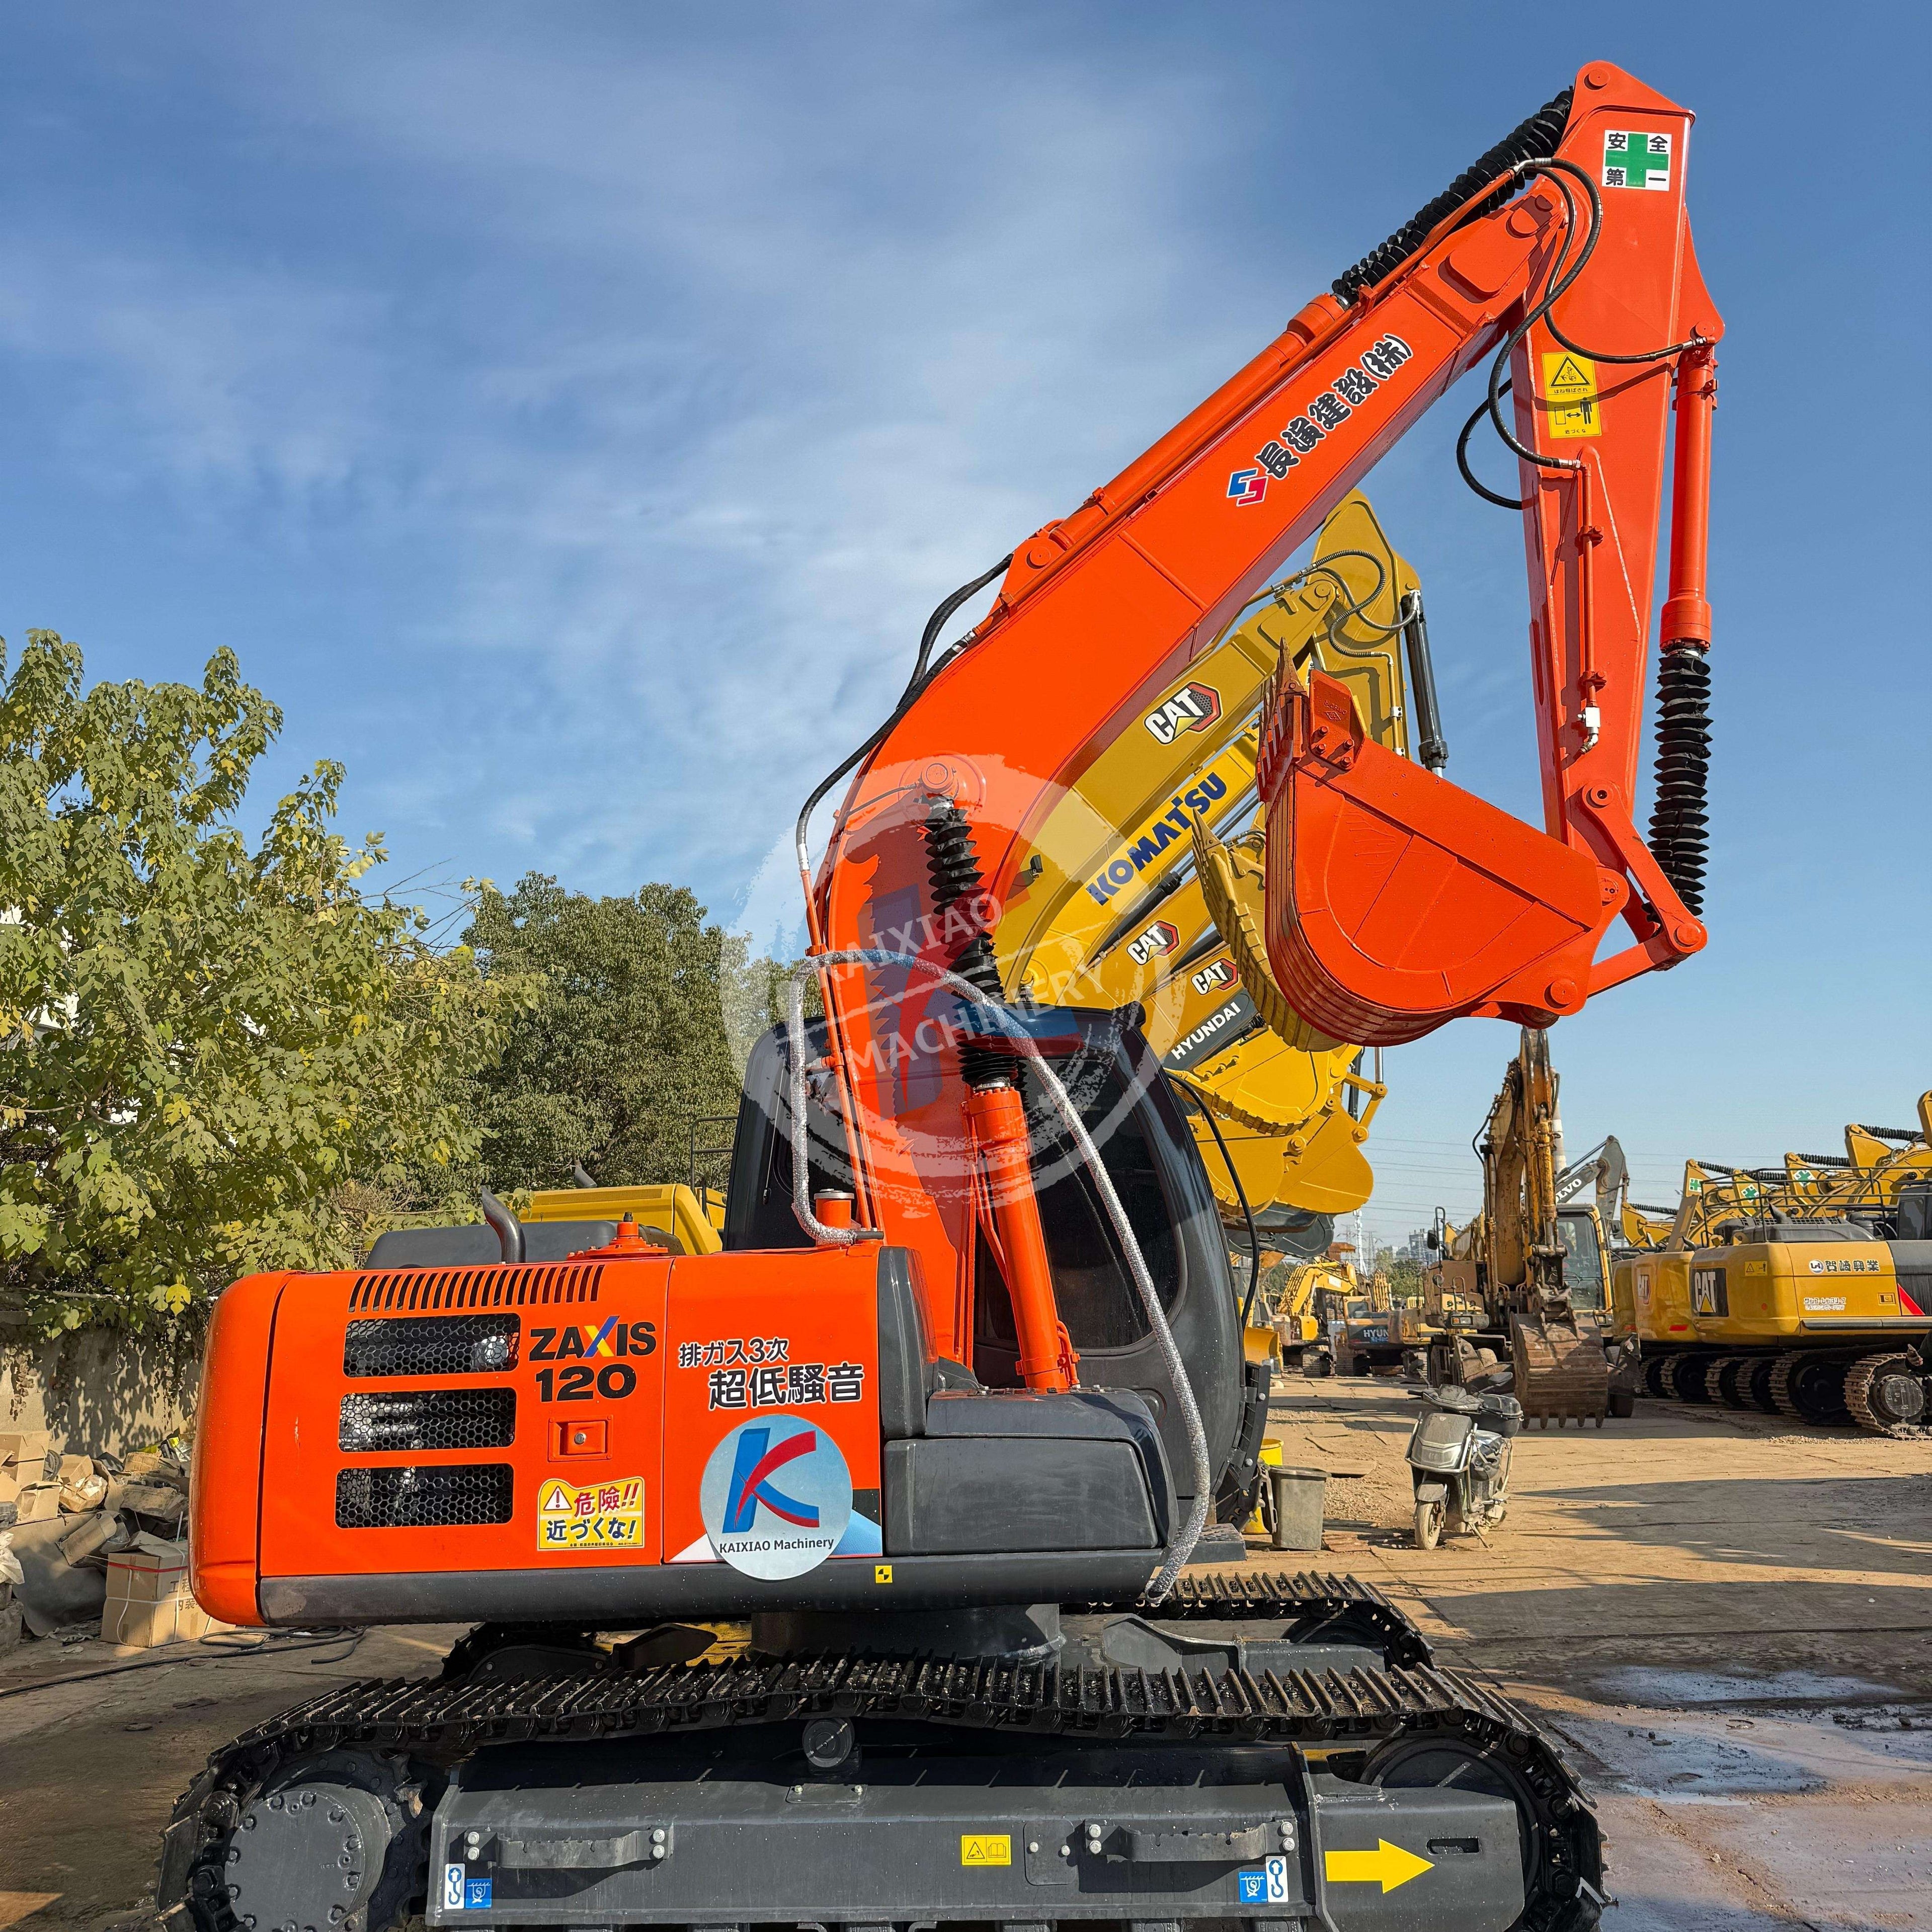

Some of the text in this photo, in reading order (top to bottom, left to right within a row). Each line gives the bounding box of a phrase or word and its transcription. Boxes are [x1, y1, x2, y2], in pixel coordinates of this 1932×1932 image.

[1145, 687, 1204, 744] CAT
[1085, 771, 1227, 906] KOMATSU
[1127, 923, 1168, 965] CAT
[1191, 961, 1228, 995] CAT
[1170, 1002, 1241, 1060] HYUNDAI
[1694, 1271, 1716, 1313] CAT
[529, 1315, 657, 1361] ZAXIS
[679, 1338, 788, 1367] 排ガス3次
[535, 1363, 637, 1402] 120
[708, 1362, 864, 1410] 超低騒音
[546, 1517, 636, 1541] 近づくな!
[719, 1538, 835, 1554] KAIXIAO Machinery
